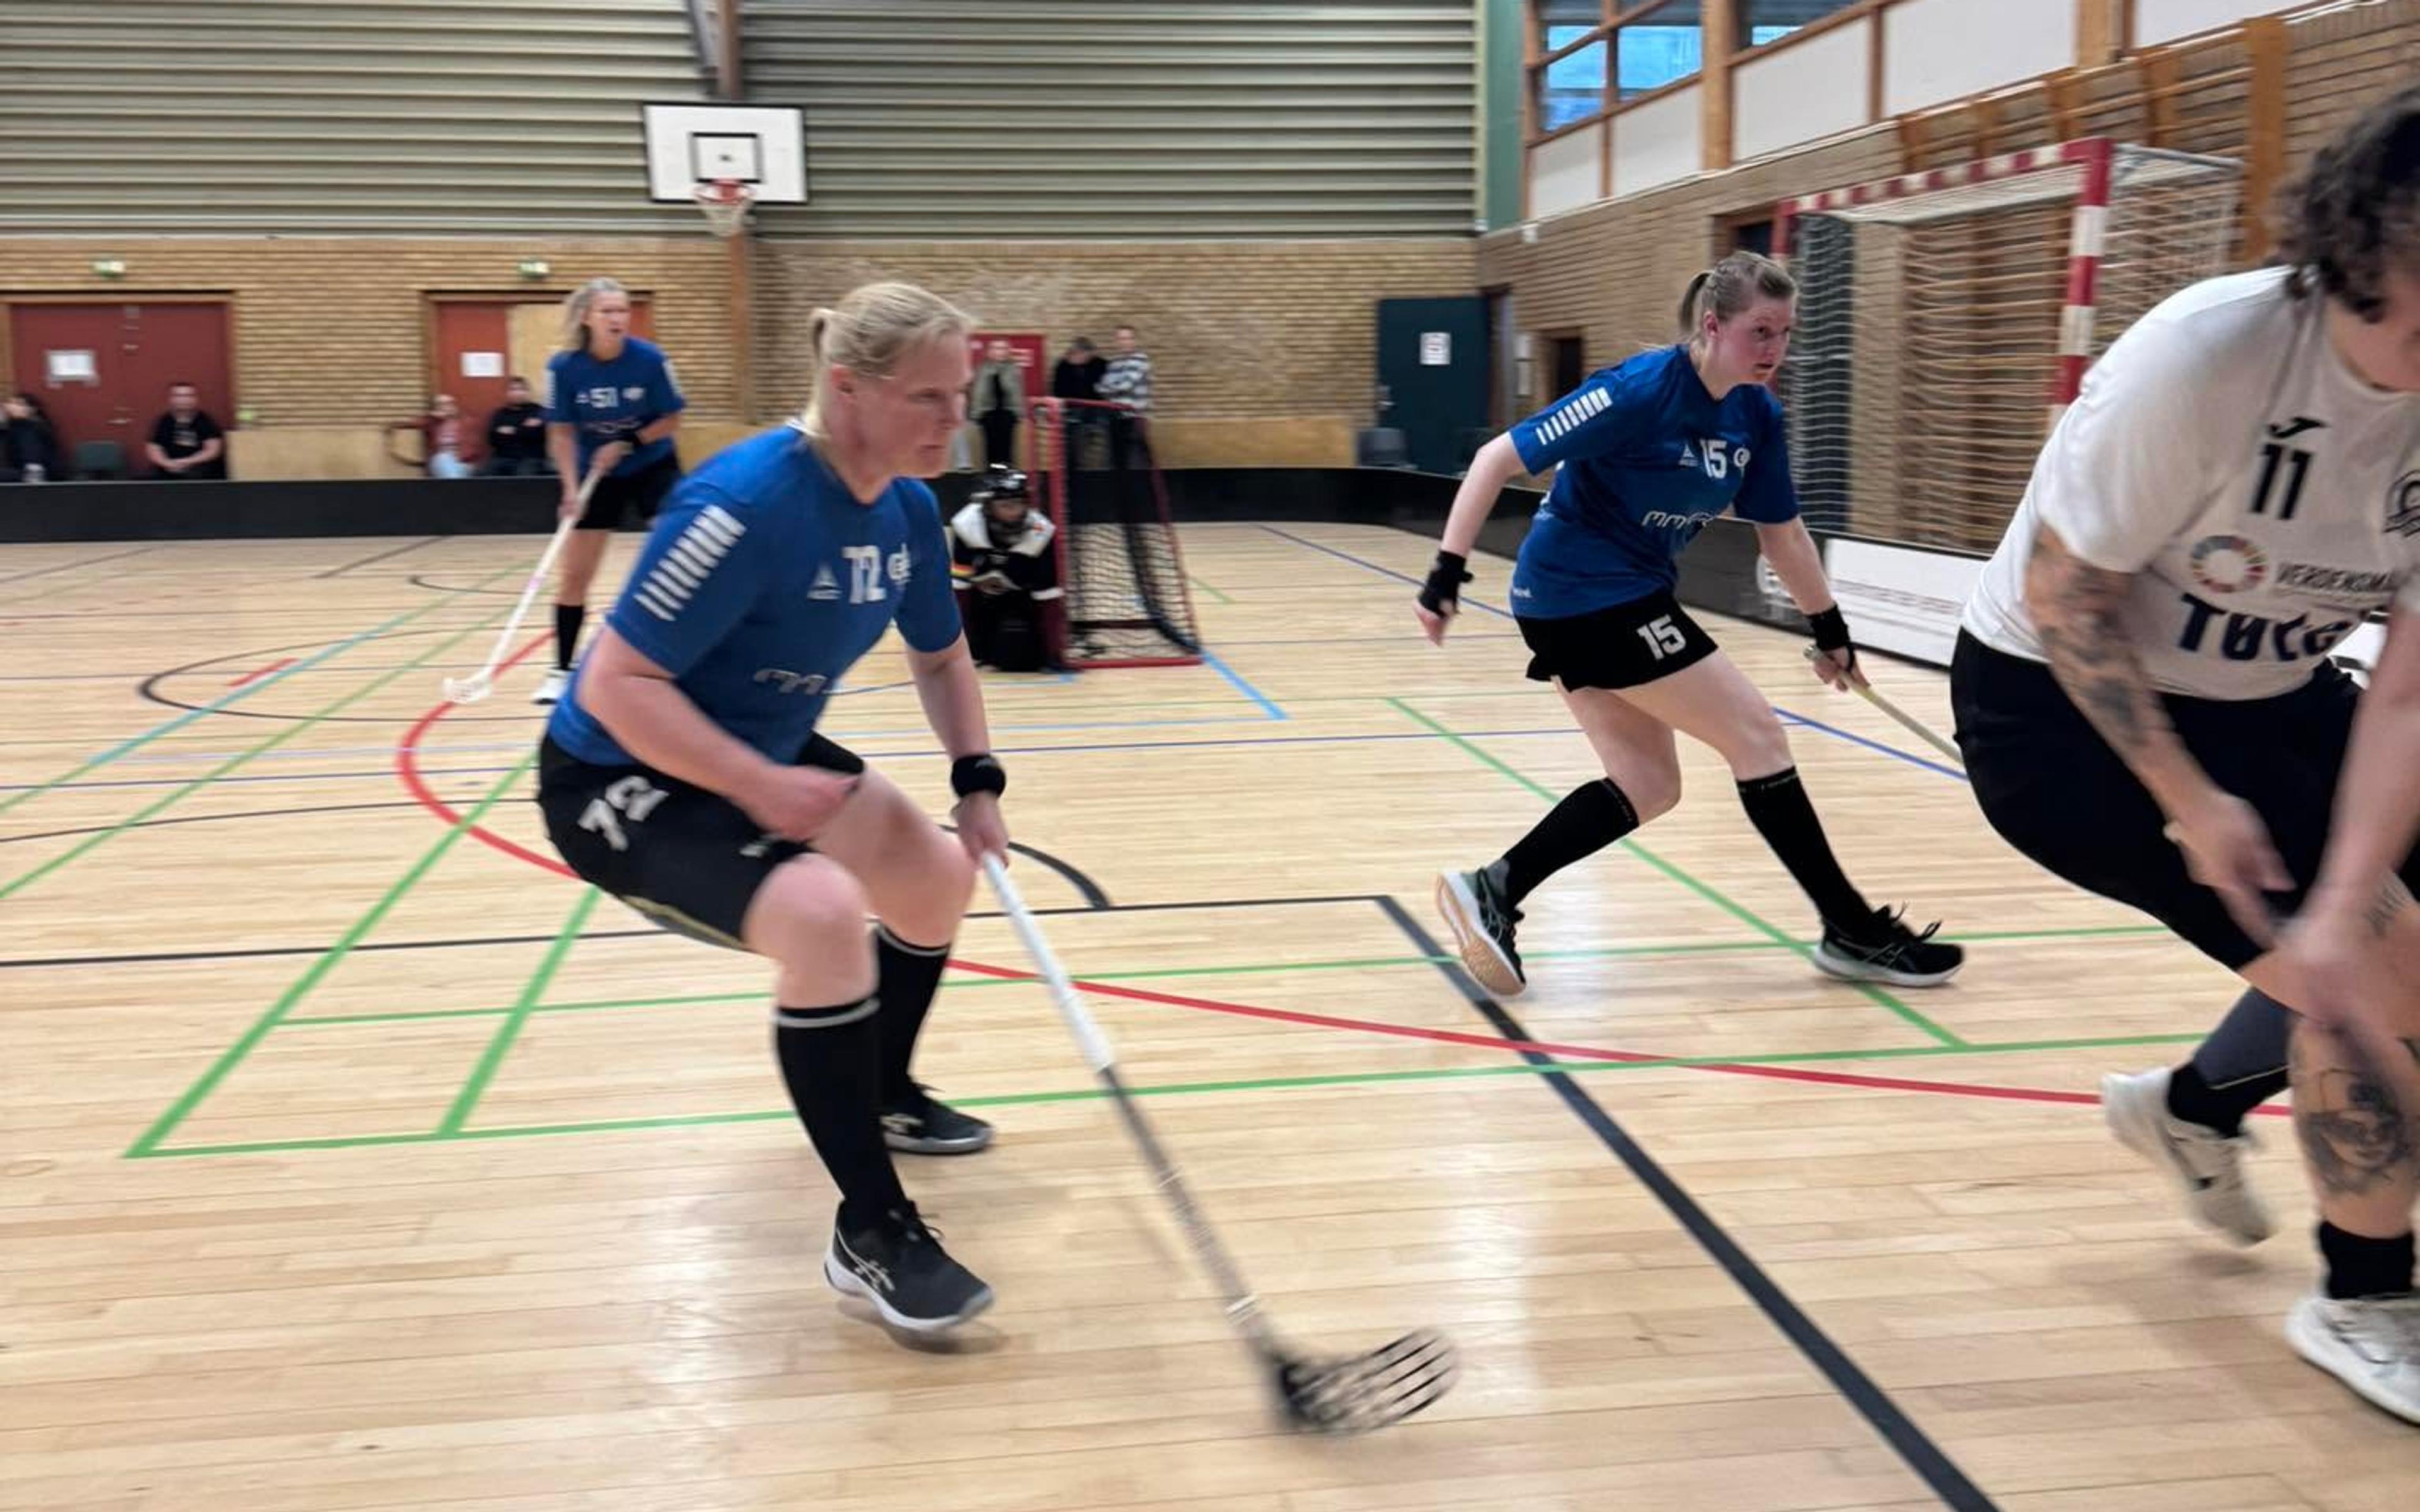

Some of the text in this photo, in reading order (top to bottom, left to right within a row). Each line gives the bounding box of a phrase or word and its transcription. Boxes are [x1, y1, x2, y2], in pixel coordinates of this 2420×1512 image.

[1700, 438, 1727, 479] 15
[2249, 442, 2314, 520] 11
[1637, 613, 1687, 660] 15
